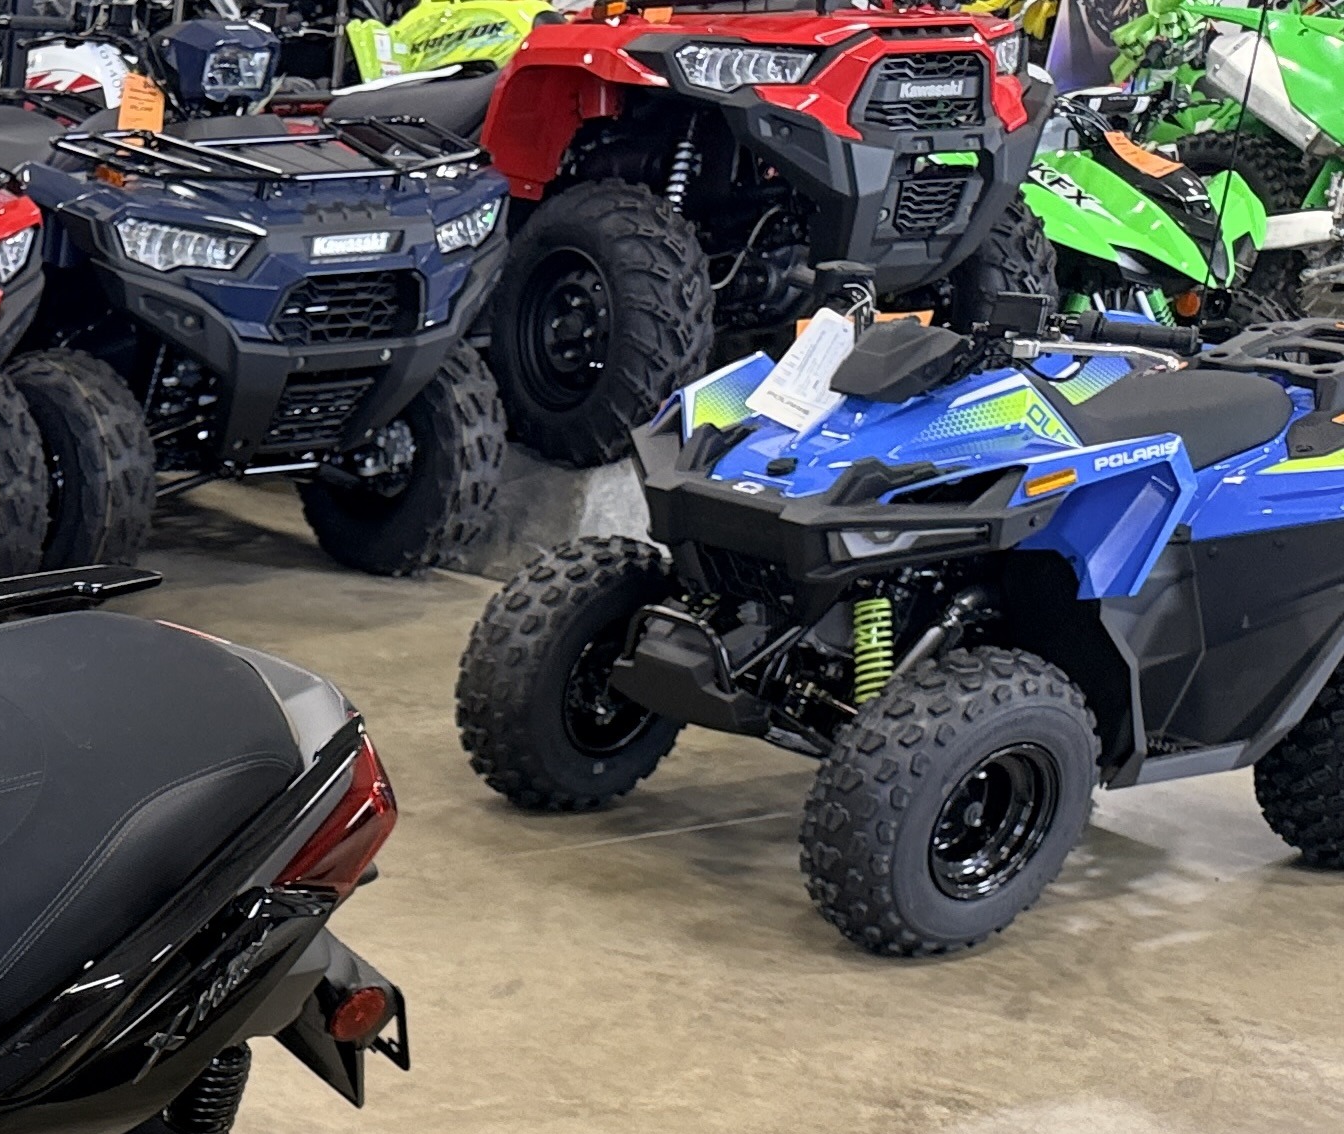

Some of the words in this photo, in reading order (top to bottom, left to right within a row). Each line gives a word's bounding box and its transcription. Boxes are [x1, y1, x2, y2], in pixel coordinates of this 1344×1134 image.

[899, 79, 964, 99] Kawasaki
[1028, 161, 1096, 207] KFX
[1094, 439, 1183, 472] POLARIS
